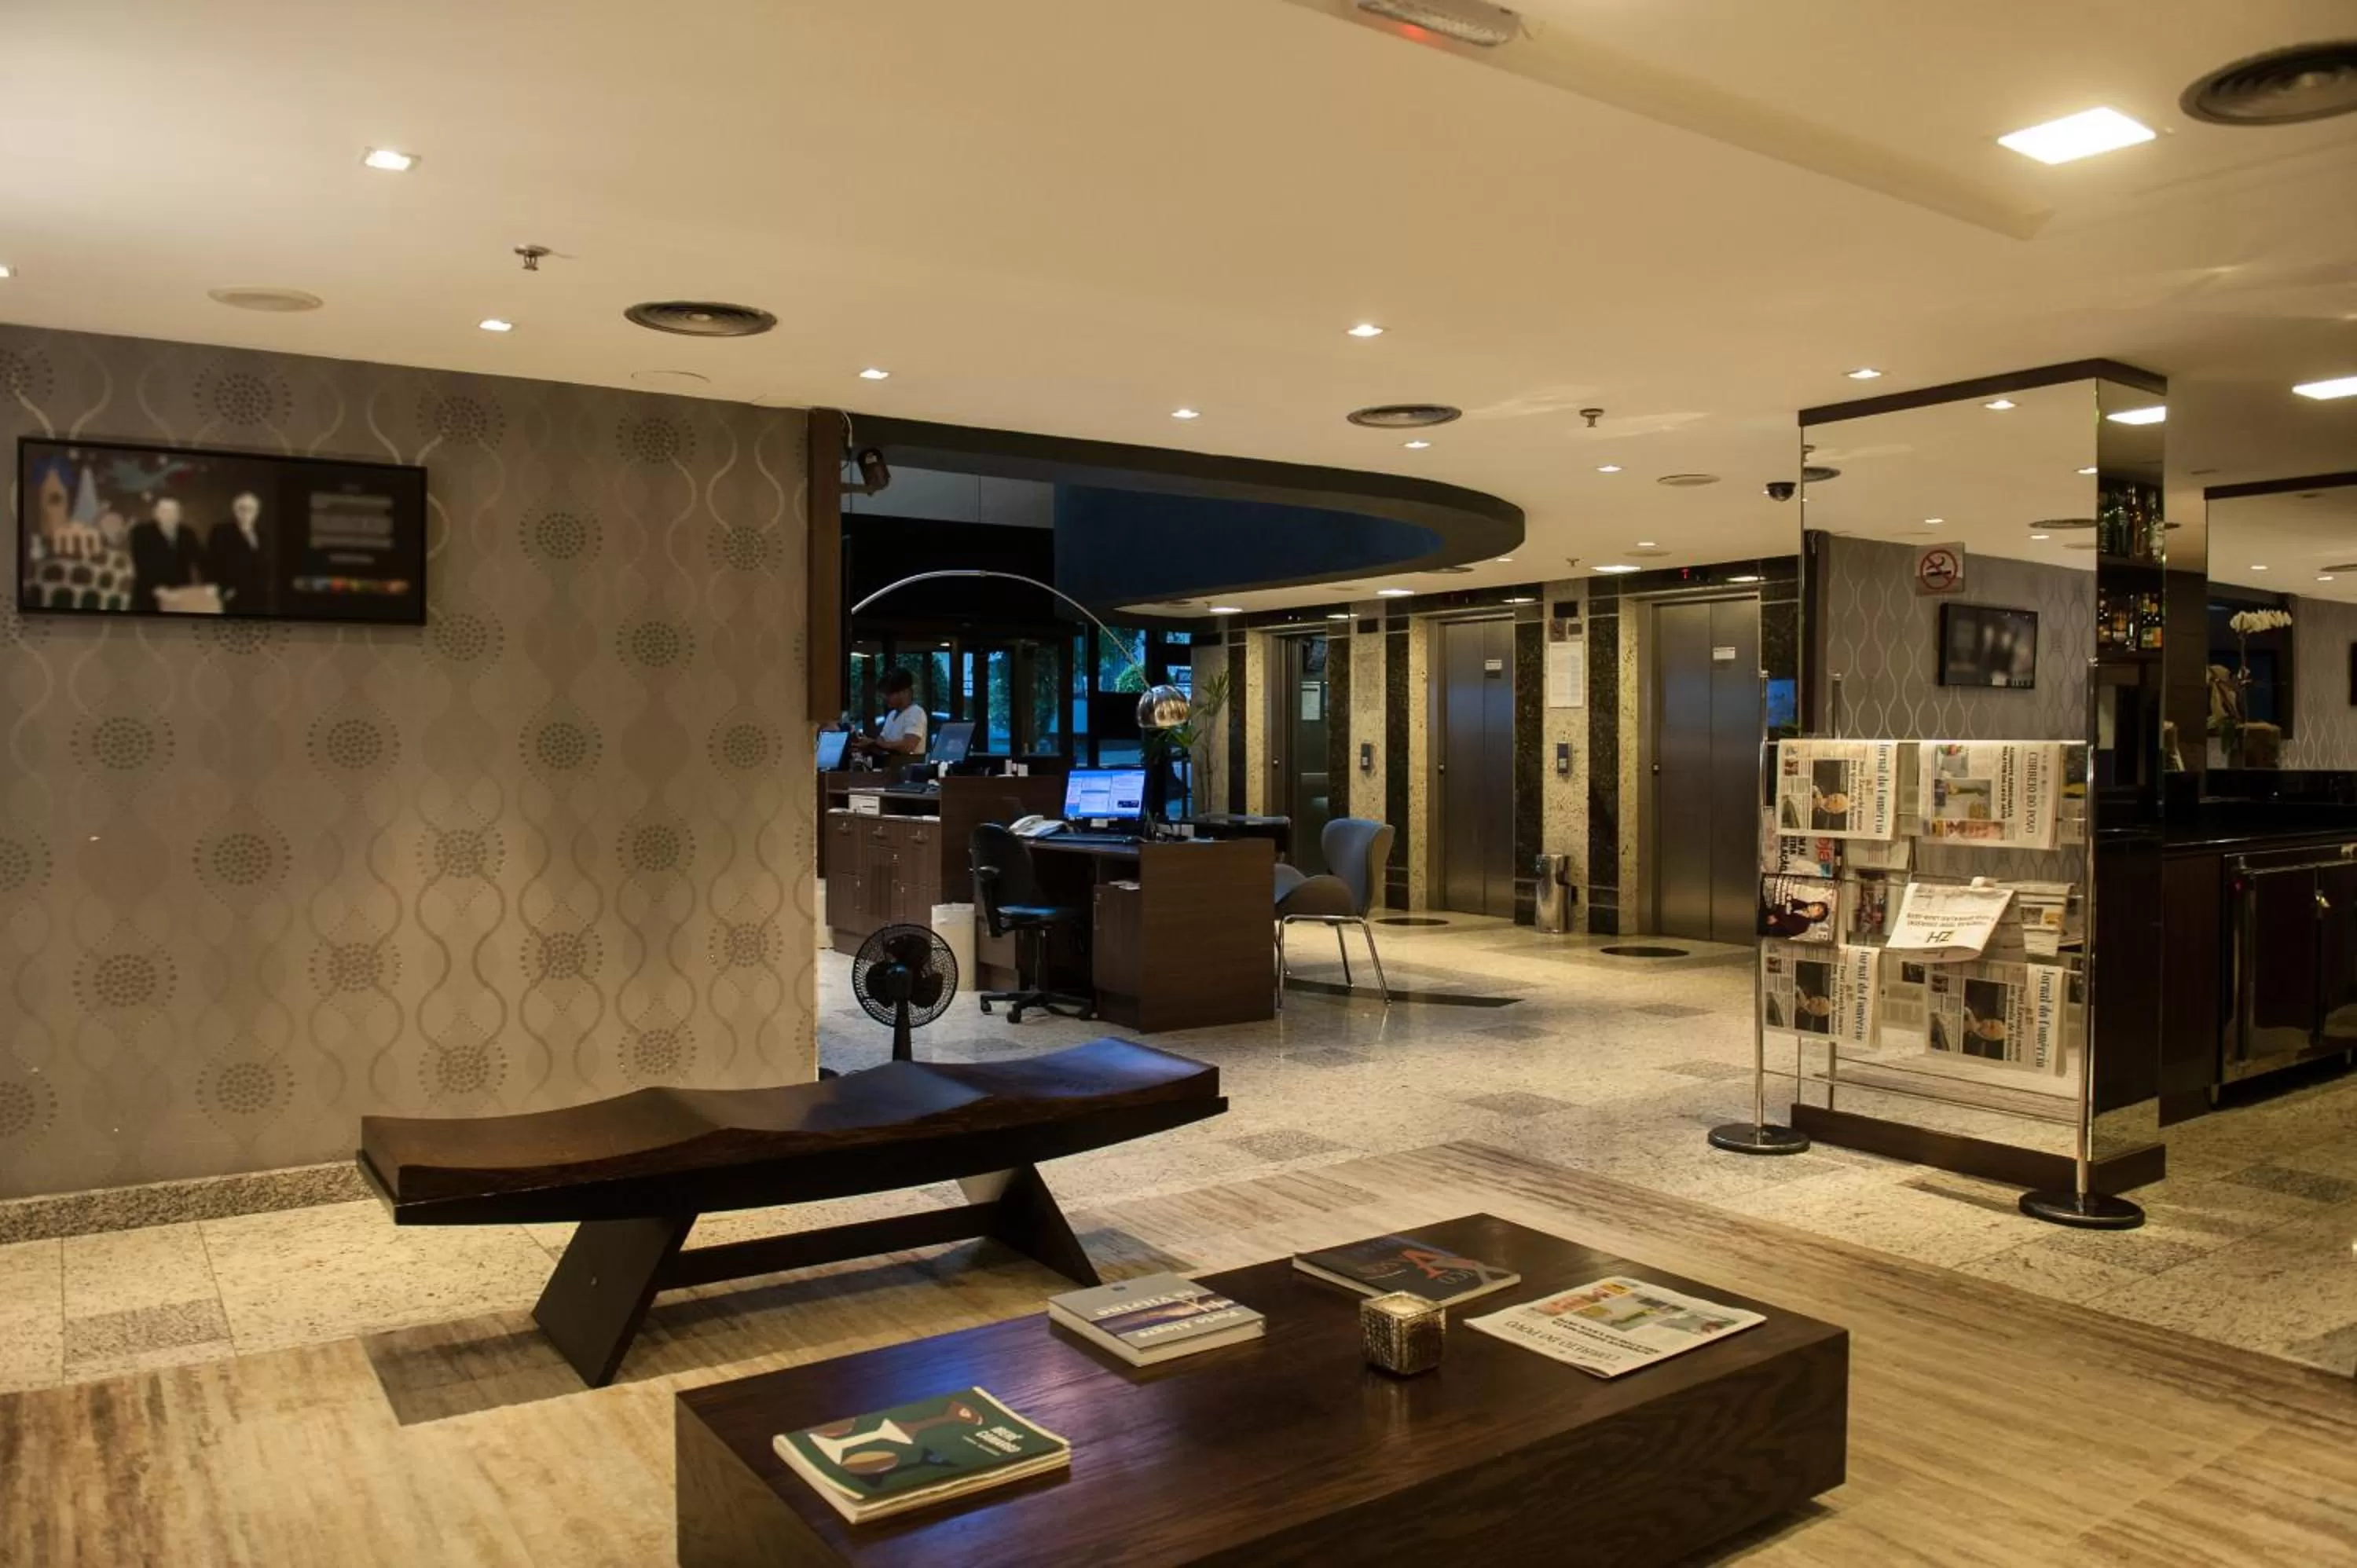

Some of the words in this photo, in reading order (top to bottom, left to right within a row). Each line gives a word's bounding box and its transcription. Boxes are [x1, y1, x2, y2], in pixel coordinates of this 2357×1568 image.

[2026, 751, 2038, 792] CORREIO
[2026, 794, 2037, 808] DO
[2025, 810, 2036, 833] POVO
[2039, 971, 2055, 1003] Jornal
[2038, 1006, 2051, 1017] do
[2036, 1020, 2051, 1068] Comércio
